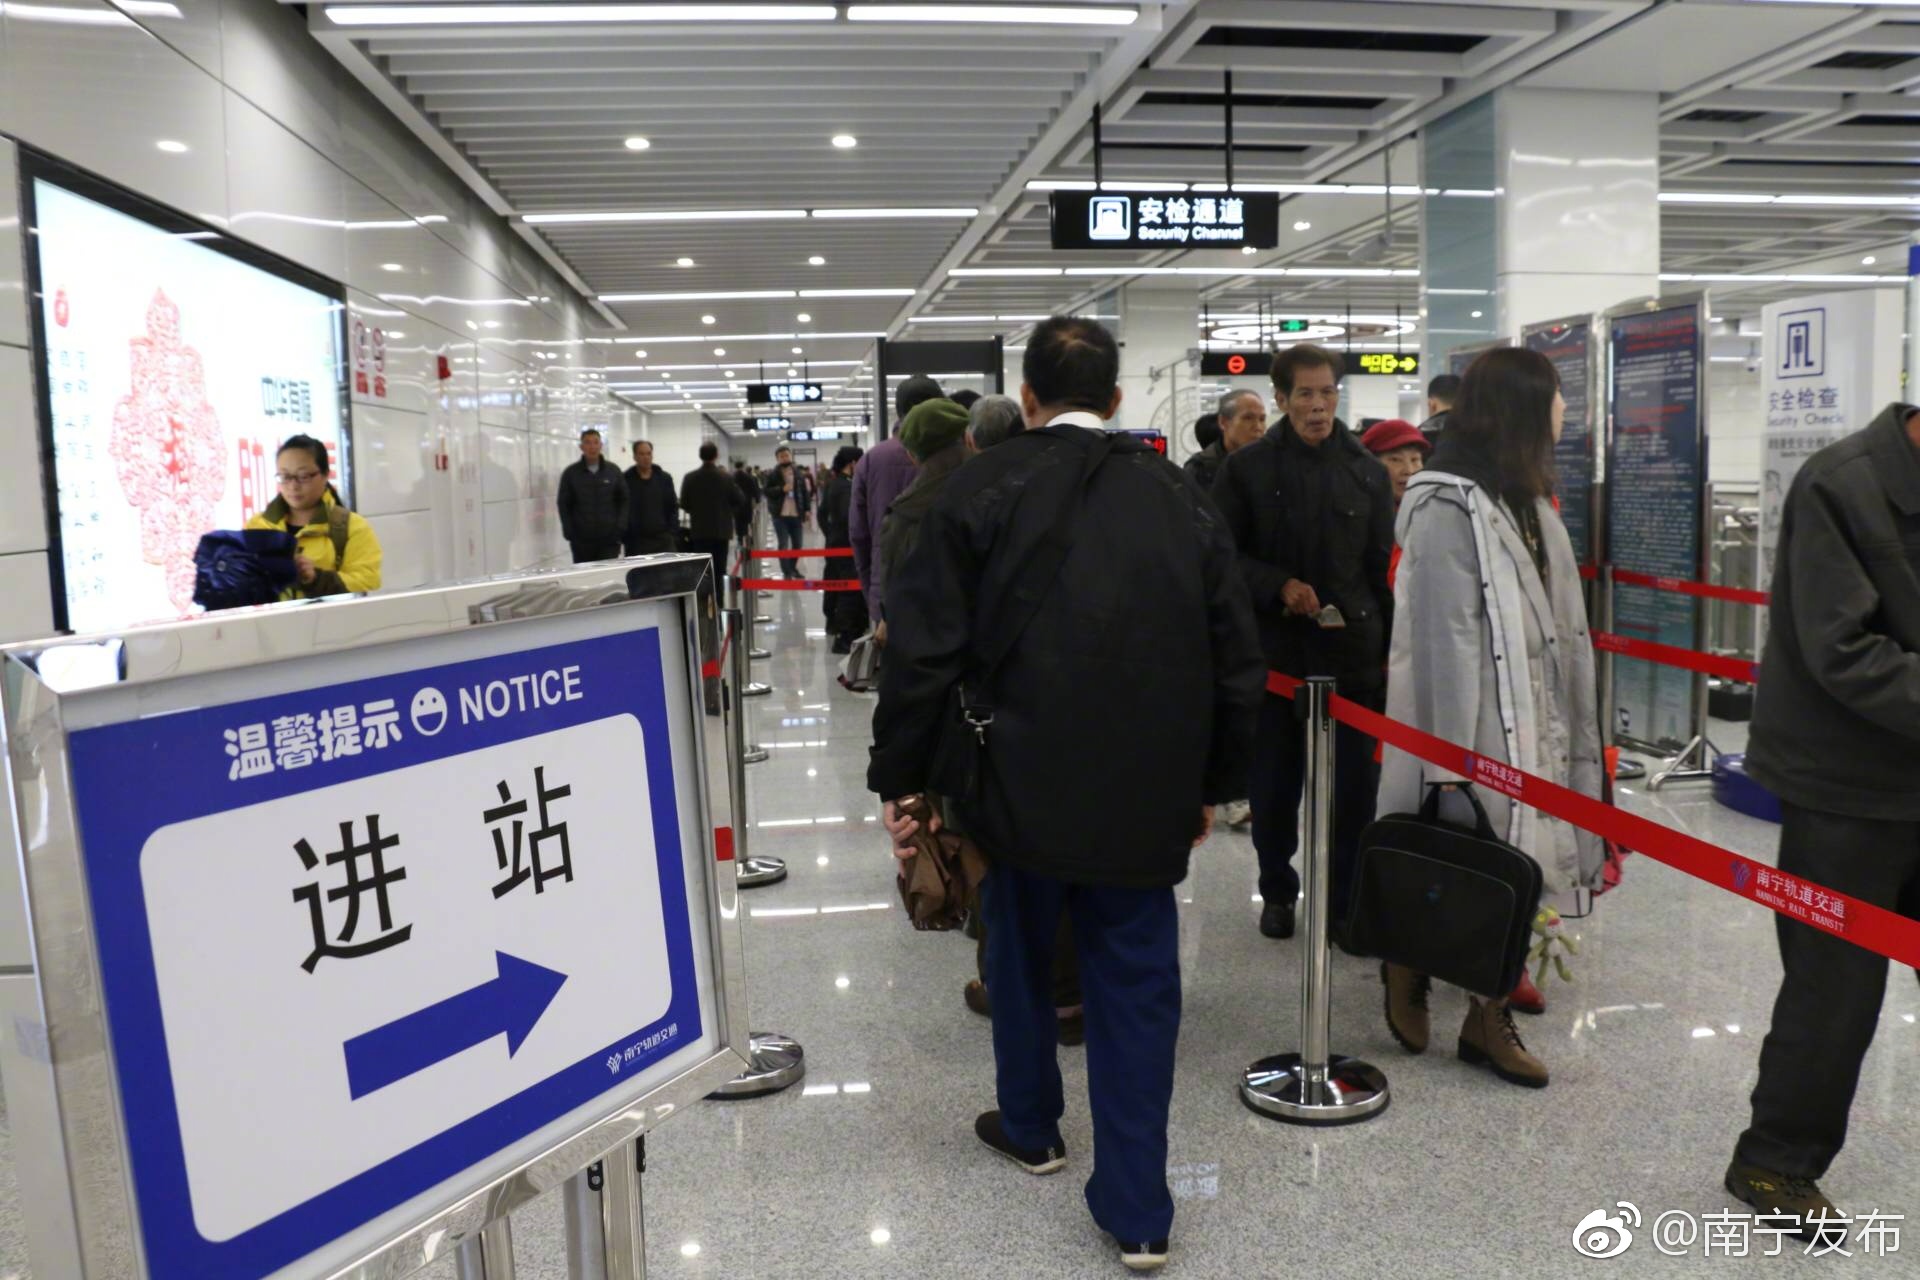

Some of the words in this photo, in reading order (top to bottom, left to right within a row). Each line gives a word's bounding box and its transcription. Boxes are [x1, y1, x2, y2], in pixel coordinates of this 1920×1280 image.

[1138, 197, 1244, 224] 安检通道
[1138, 226, 1189, 242] Security
[1192, 226, 1244, 240] Channel
[1768, 386, 1839, 412] 安全检查
[224, 699, 403, 781] 温馨提示
[459, 665, 584, 725] NOTICE
[1477, 758, 1522, 787] 南宁轨道交通
[292, 766, 573, 975] 进站
[1755, 889, 1786, 908] NANNING
[1788, 902, 1808, 918] RAIL
[1811, 911, 1845, 933] TRANSIT
[1757, 868, 1845, 919] 南宁轨道交通
